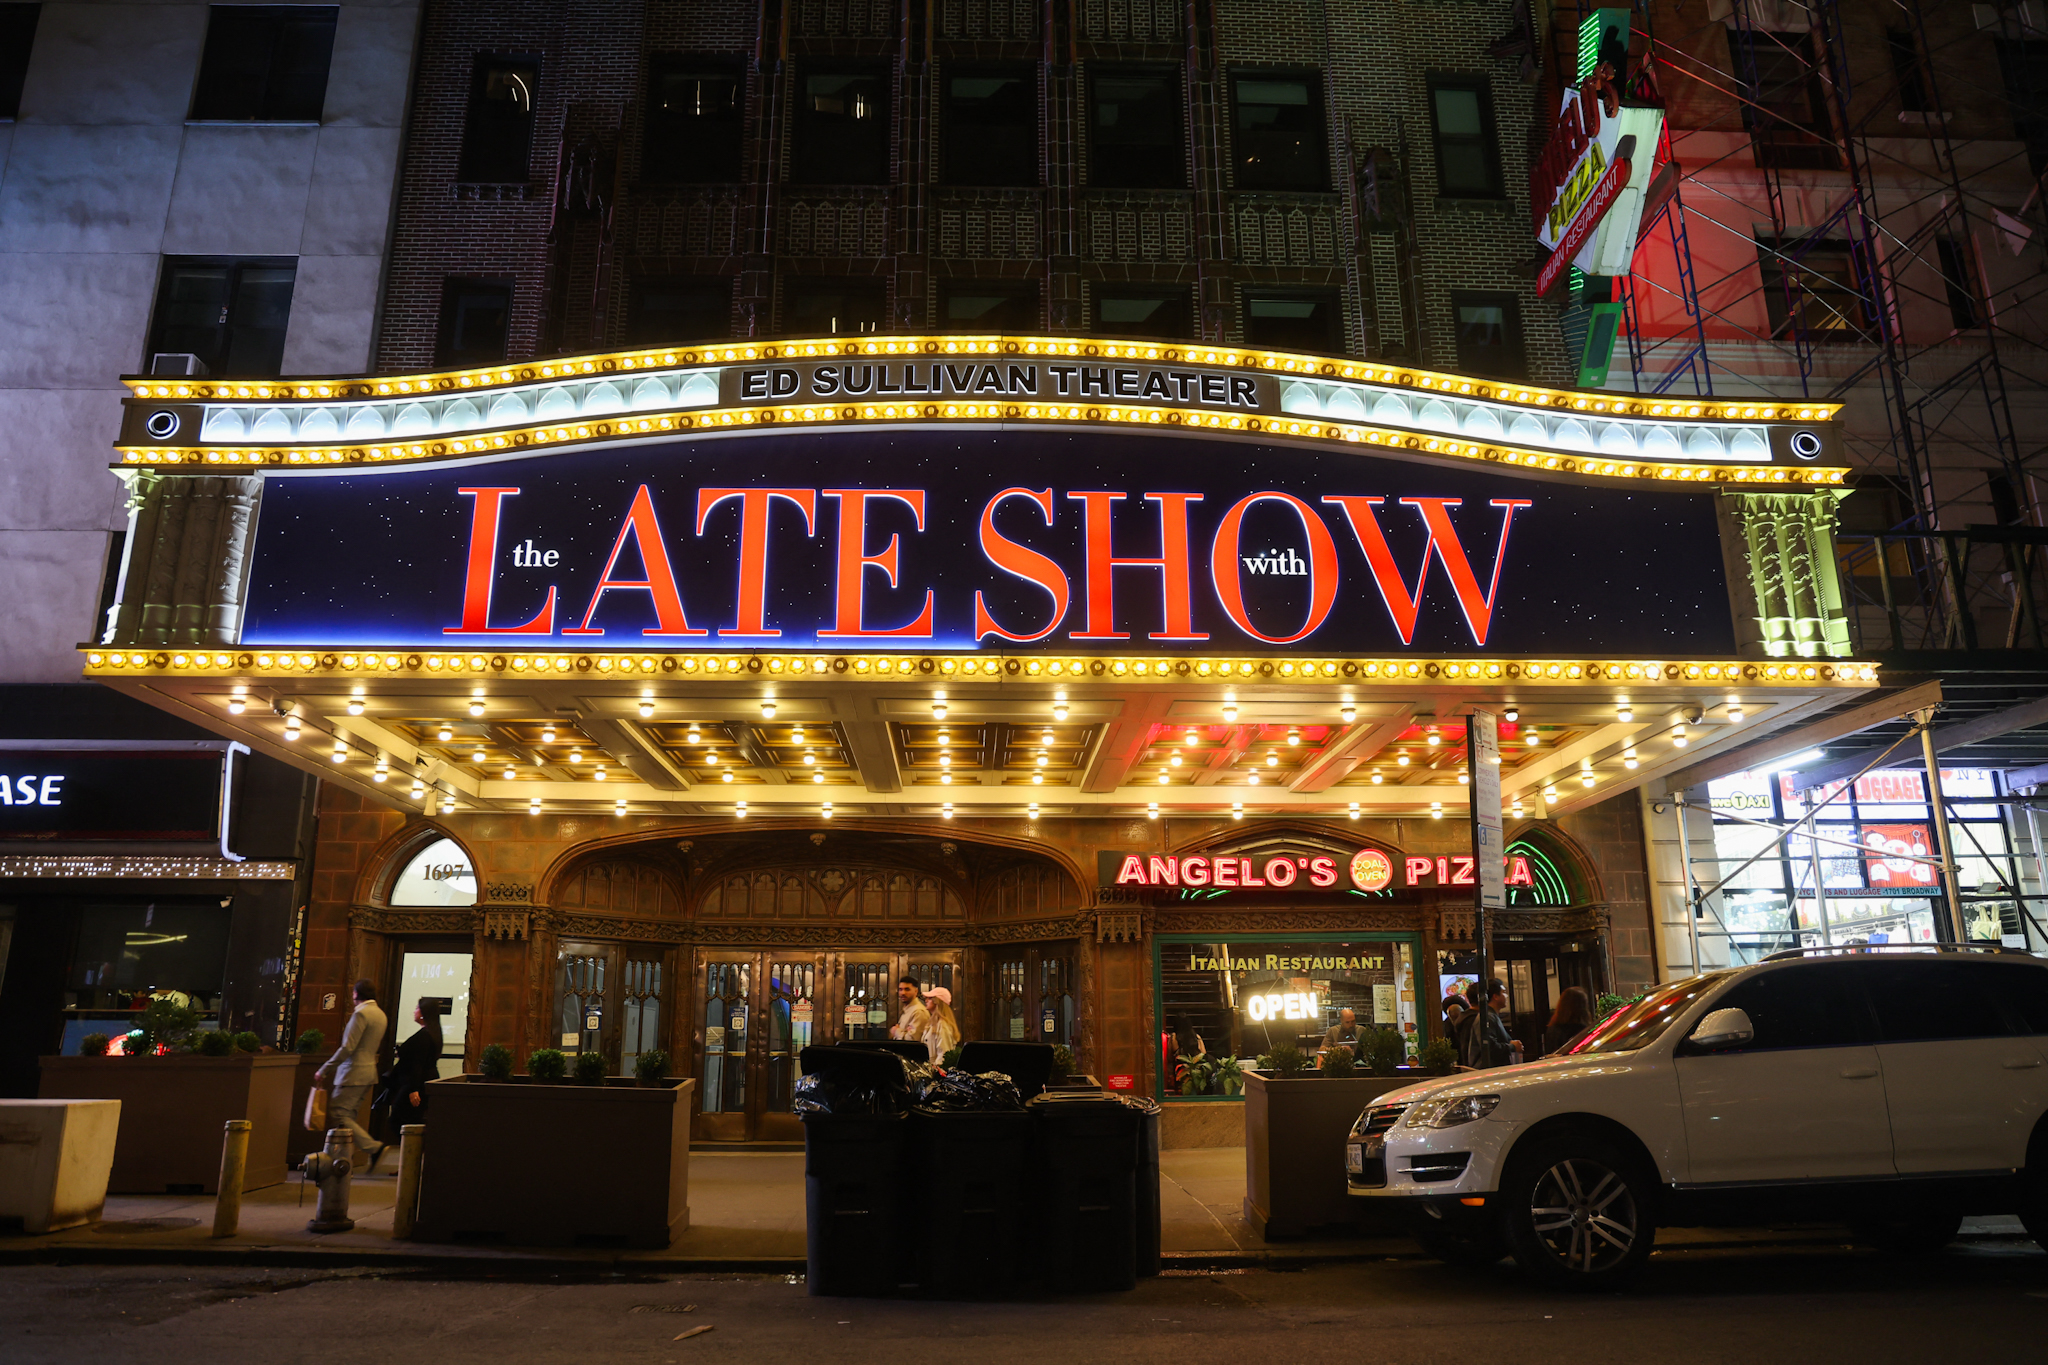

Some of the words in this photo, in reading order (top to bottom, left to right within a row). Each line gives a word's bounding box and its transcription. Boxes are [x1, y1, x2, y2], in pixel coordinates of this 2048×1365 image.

[1548, 141, 1607, 243] PIZZA
[1540, 245, 1565, 291] ITALIAN
[1566, 165, 1618, 254] RESTAURANT
[740, 368, 801, 400] ED
[811, 364, 1038, 397] SULLIVAN
[1048, 366, 1260, 408] THEATER
[442, 484, 934, 638] LATE
[974, 487, 1533, 646] SHOW
[512, 540, 560, 568] the
[1242, 548, 1308, 577] with
[1731, 791, 1771, 810] TAXI
[1854, 775, 1924, 801] LUGGAGE
[1480, 829, 1487, 845] 6
[423, 864, 464, 881] 1697
[1115, 854, 1338, 887] ANGELO'S
[1354, 859, 1387, 870] COAL
[1356, 870, 1387, 882] OVEN
[1405, 856, 1534, 886] PIZA
[1834, 888, 1848, 896] AND
[1850, 888, 1882, 896] LUGGAGE
[1902, 887, 1939, 895] BROADWAY
[1190, 954, 1260, 971] ITALIAN
[1266, 954, 1385, 971] RESTAURANT
[1248, 992, 1319, 1021] OPEN
